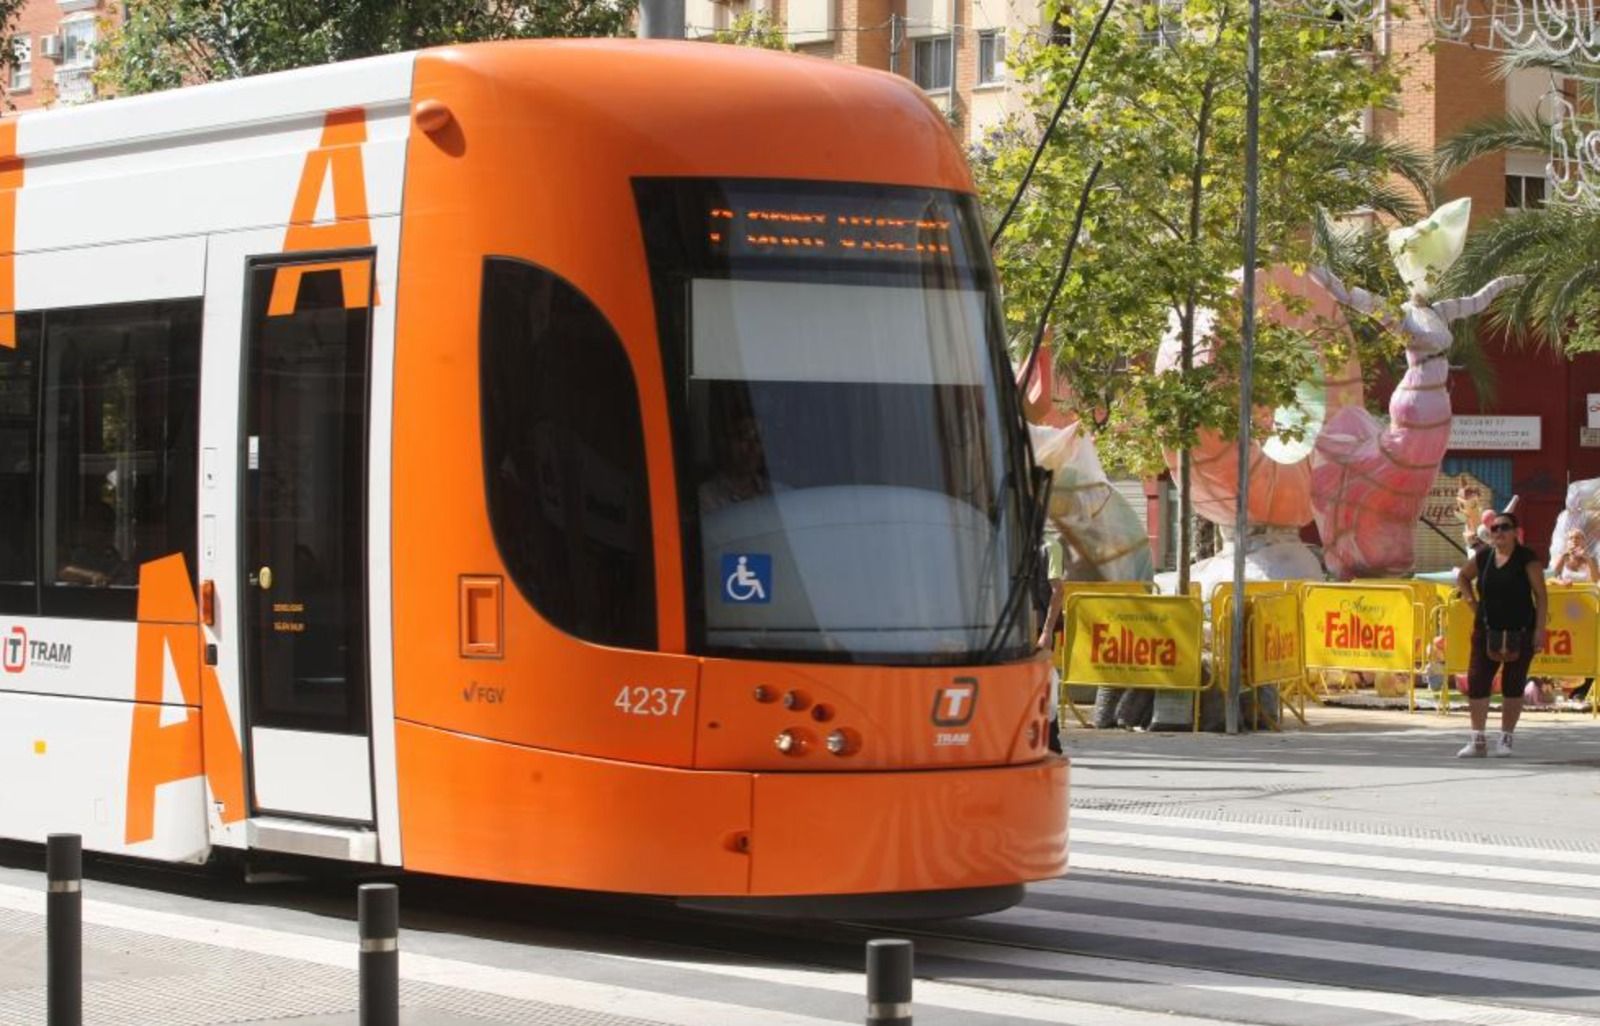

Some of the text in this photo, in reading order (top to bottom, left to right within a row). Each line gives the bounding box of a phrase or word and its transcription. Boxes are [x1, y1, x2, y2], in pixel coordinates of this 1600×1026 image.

[1091, 623, 1176, 666] Fallera
[1325, 611, 1395, 650] Fallera
[29, 640, 72, 664] TRAM
[477, 686, 506, 704] FGV
[614, 685, 687, 716] 4237
